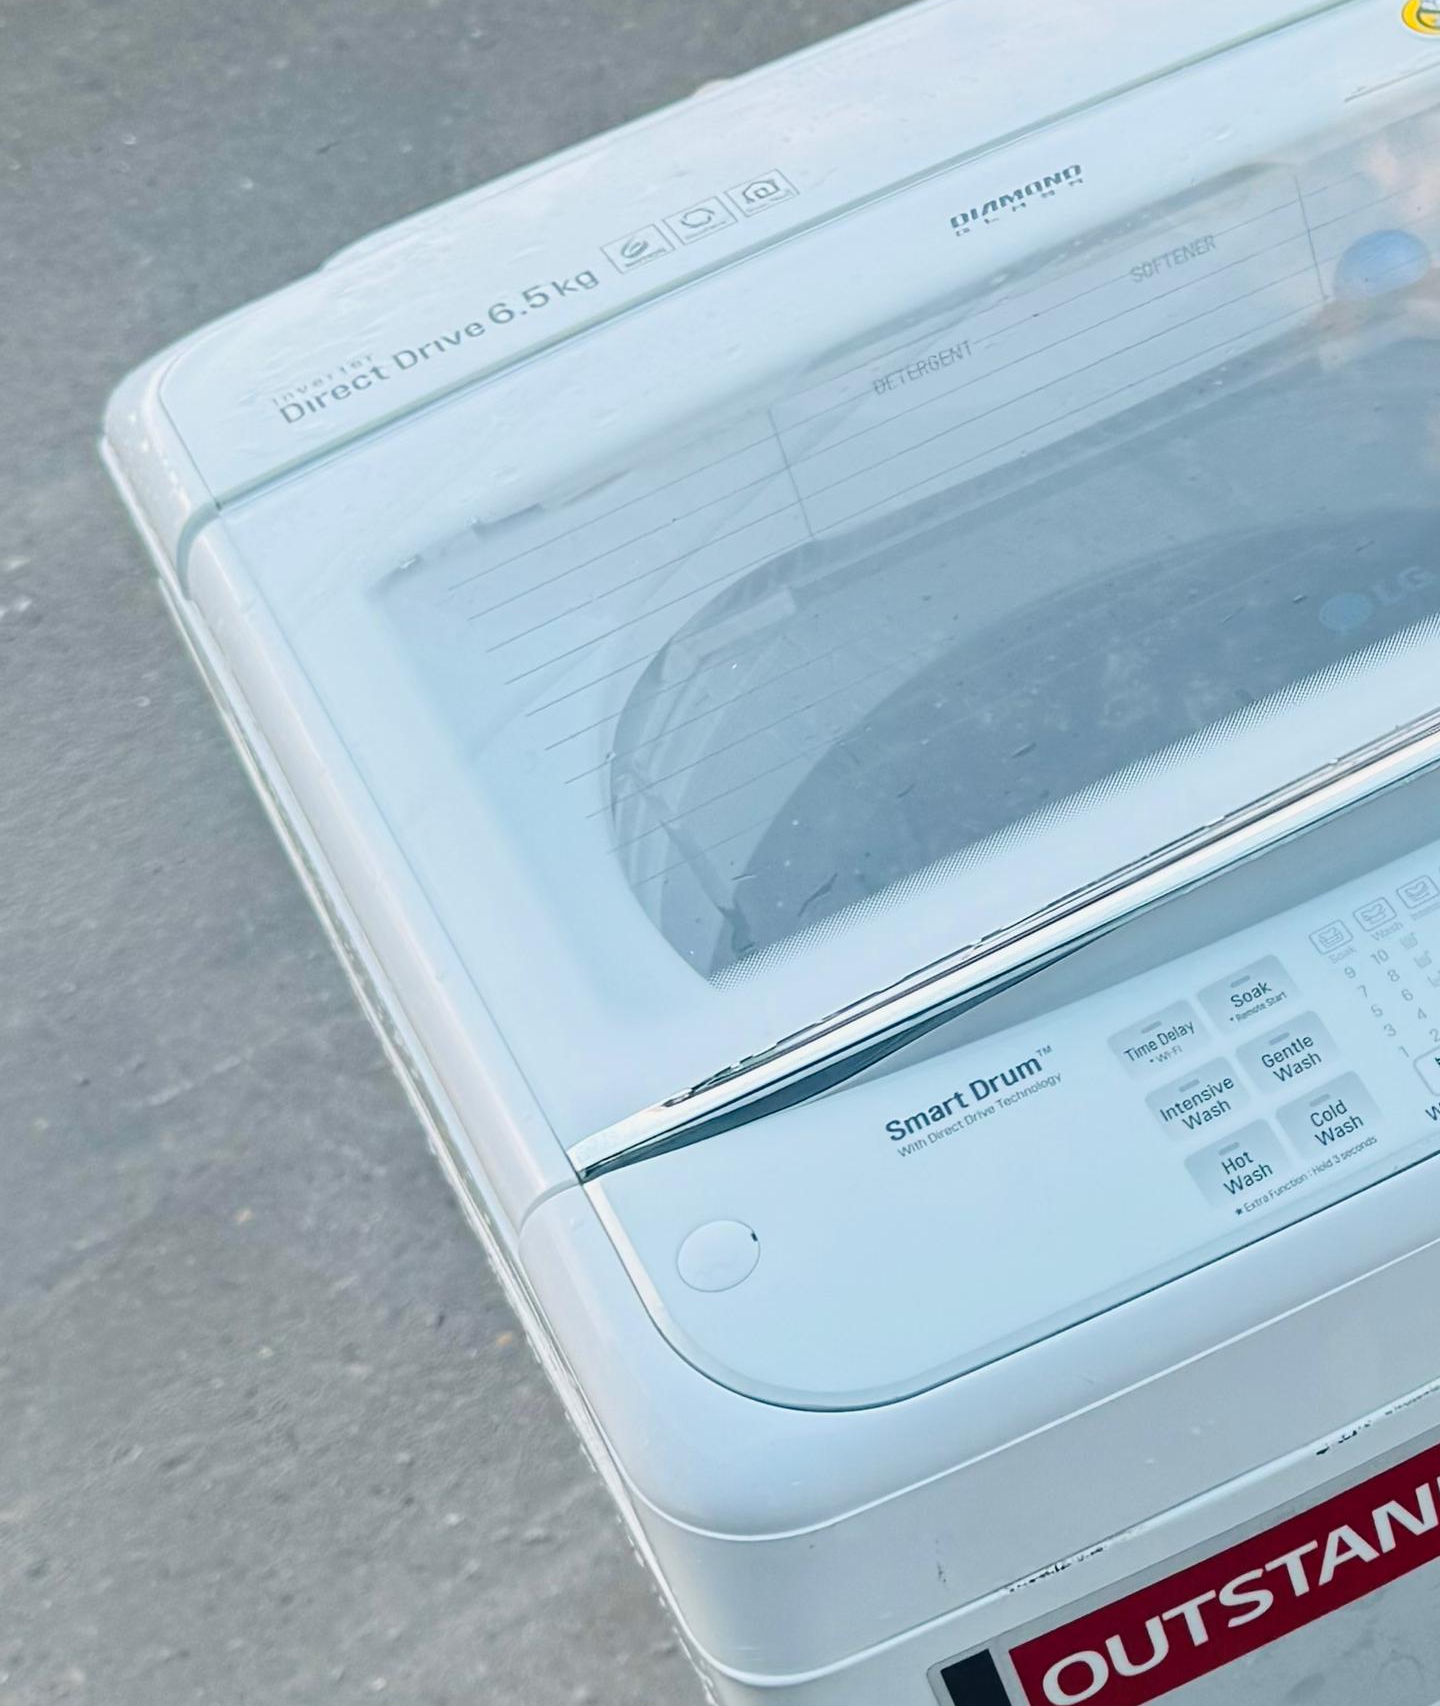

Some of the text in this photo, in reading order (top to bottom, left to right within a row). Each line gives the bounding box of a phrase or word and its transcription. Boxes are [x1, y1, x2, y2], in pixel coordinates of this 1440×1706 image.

[950, 165, 1081, 228] DIAMOND
[1129, 235, 1217, 284] SOFTENER
[279, 366, 390, 424] Direct
[391, 320, 486, 373] Drive
[872, 340, 974, 396] DETERGENT
[1344, 948, 1389, 979] 9 10
[1229, 981, 1272, 1008] Soak
[1357, 969, 1401, 998] 7 8
[1371, 988, 1413, 1018] 5 6
[1384, 1007, 1428, 1037] 3 4
[1123, 1020, 1196, 1064] Time Delay
[1260, 1034, 1314, 1070] Gentle
[1399, 1045, 1410, 1058] 1
[1273, 1052, 1322, 1083] Wash
[885, 1090, 970, 1142] Smart
[897, 1073, 1062, 1158] With Direct Drive Technology
[1159, 1076, 1235, 1122] Intensive
[1182, 1098, 1232, 1131] Wash
[1310, 1099, 1348, 1128] Cold
[1314, 1114, 1365, 1148] Wash
[1220, 1150, 1255, 1175] Hot
[1223, 1162, 1274, 1196] Wash
[1243, 1193, 1270, 1214] Extra
[1268, 1171, 1309, 1199] Function
[1312, 1157, 1334, 1175] Hold
[1332, 1153, 1342, 1165] 3
